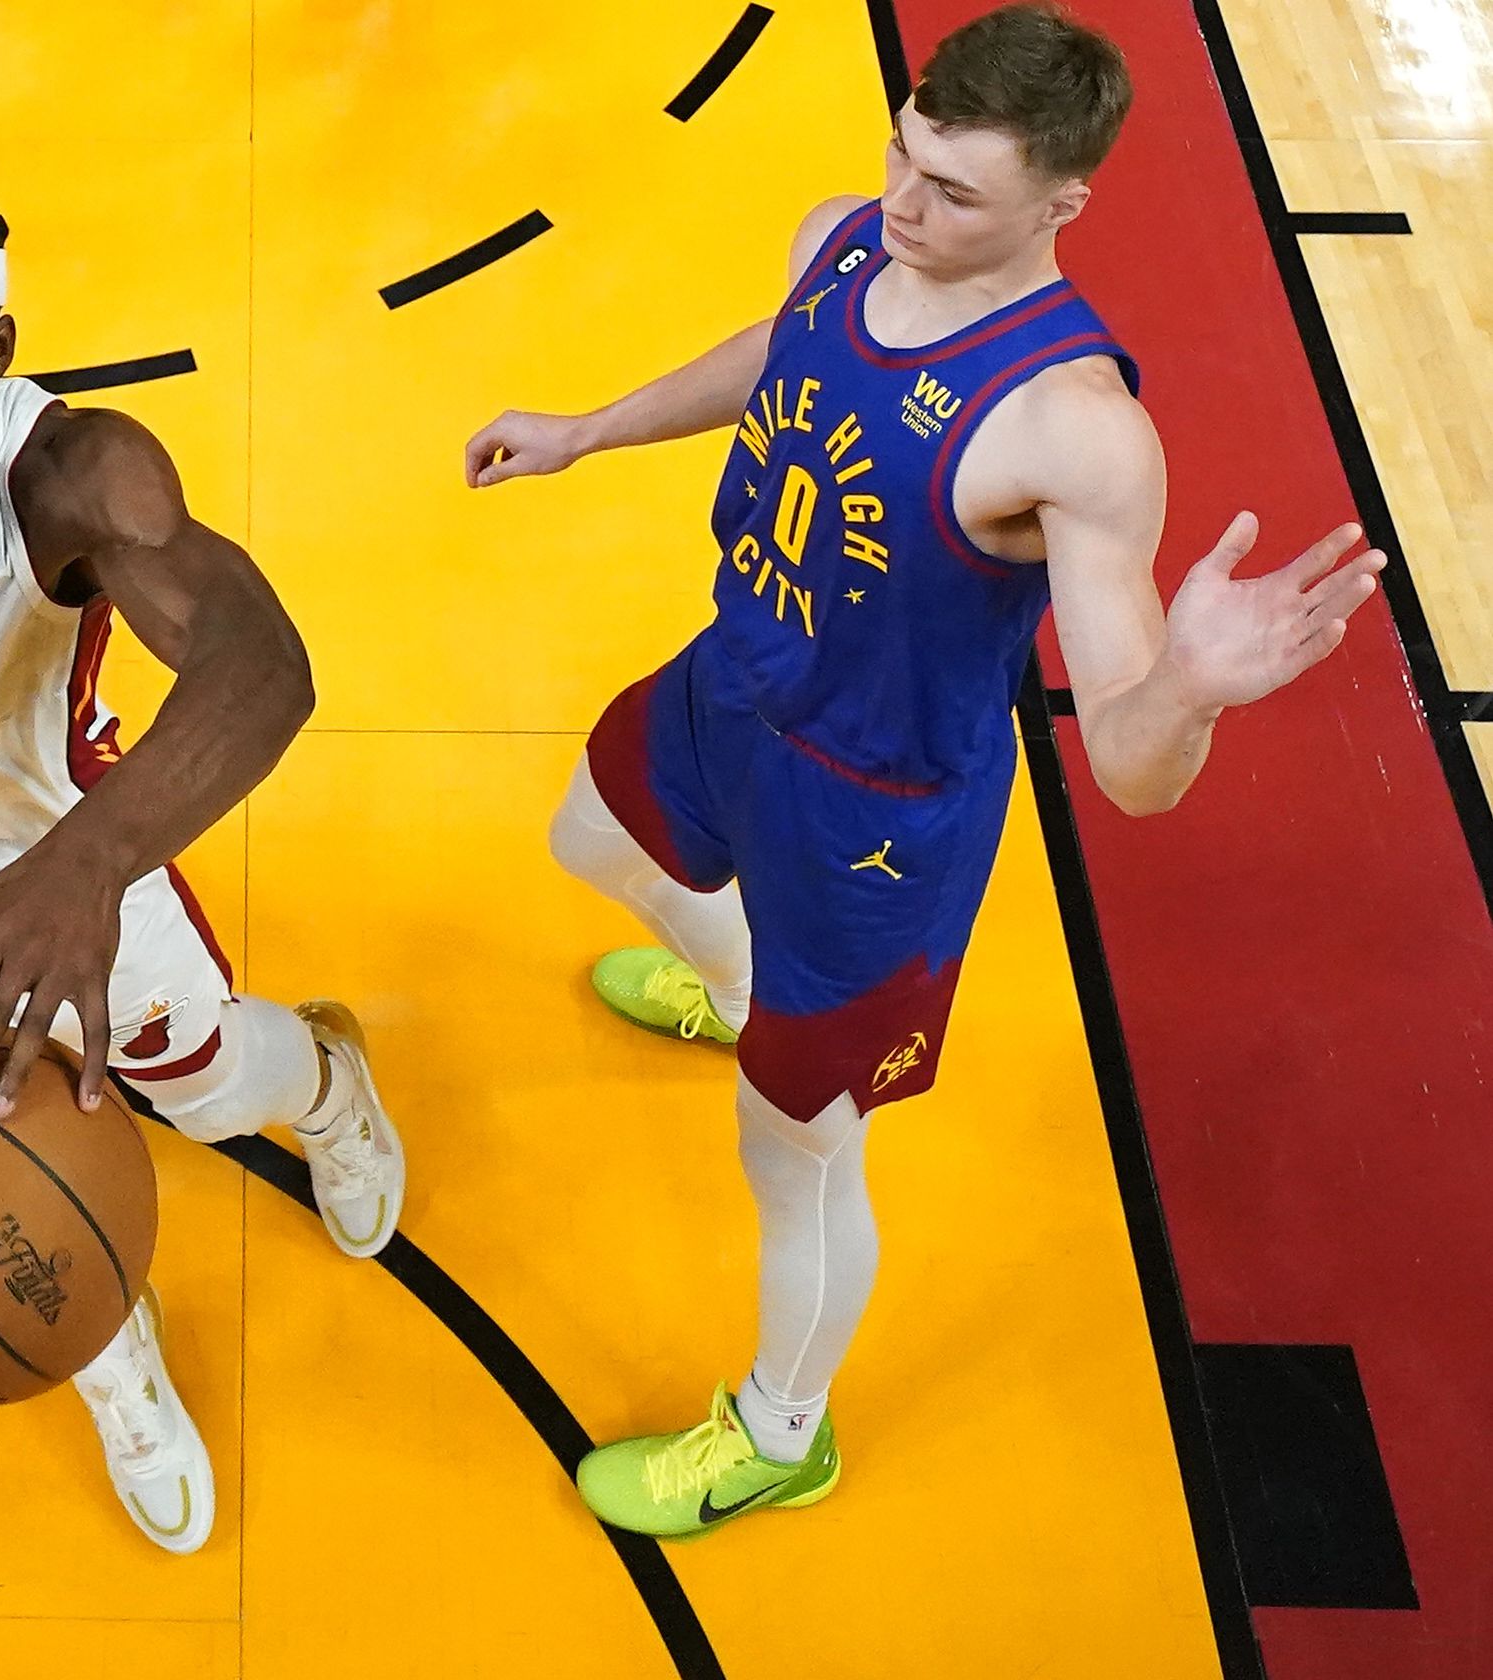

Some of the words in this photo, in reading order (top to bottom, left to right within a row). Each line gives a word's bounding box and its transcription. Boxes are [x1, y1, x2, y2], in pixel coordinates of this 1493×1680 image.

[838, 248, 867, 274] 6
[901, 394, 943, 434] Western
[913, 370, 962, 419] WU
[901, 410, 930, 440] Union
[738, 377, 822, 468] MILE
[824, 412, 891, 574] HIGH
[772, 463, 820, 568] 0
[731, 533, 815, 638] CITY
